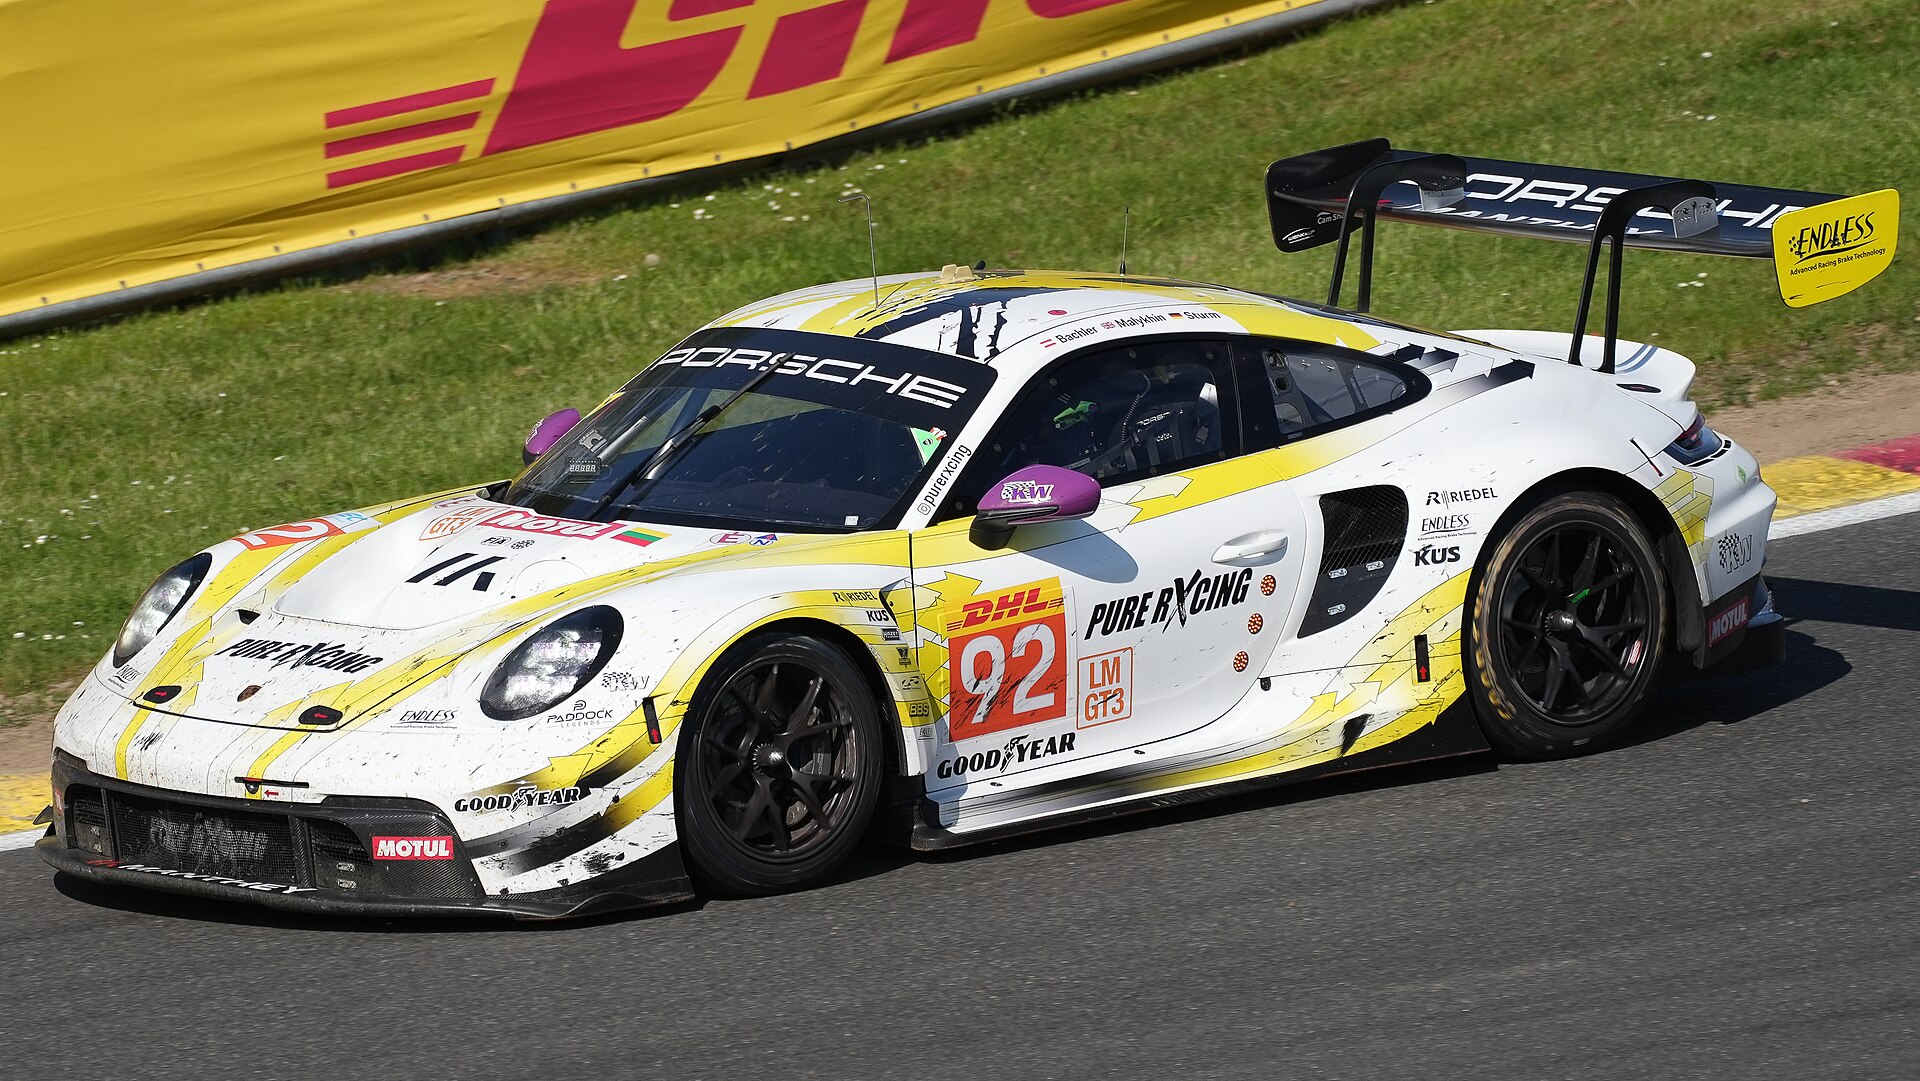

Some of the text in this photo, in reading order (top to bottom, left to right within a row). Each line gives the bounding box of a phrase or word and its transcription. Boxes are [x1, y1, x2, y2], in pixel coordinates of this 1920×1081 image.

[1797, 211, 1875, 256] ENDLESS
[1790, 248, 1886, 276] Advanced Racing Brake Technology
[1055, 311, 1221, 343] Bachler Malykhin Sturm
[650, 346, 968, 409] PORSCHE
[1008, 483, 1054, 502] KW
[1450, 487, 1498, 503] RIEDEL
[486, 513, 614, 537] MOTUL
[1421, 514, 1470, 531] ENDLESS
[846, 591, 877, 601] RIEDEL
[962, 587, 1052, 628] DHL
[1084, 591, 1151, 641] PURE
[1711, 602, 1747, 641] MOTUL
[214, 639, 292, 661] PURE
[960, 623, 1056, 724] 92
[1089, 656, 1121, 690] LM
[399, 709, 459, 721] ENDLESS
[547, 709, 613, 724] PADDOCK
[909, 703, 929, 717] BBS
[1084, 688, 1125, 722] GT3
[376, 838, 450, 858] MOTUL
